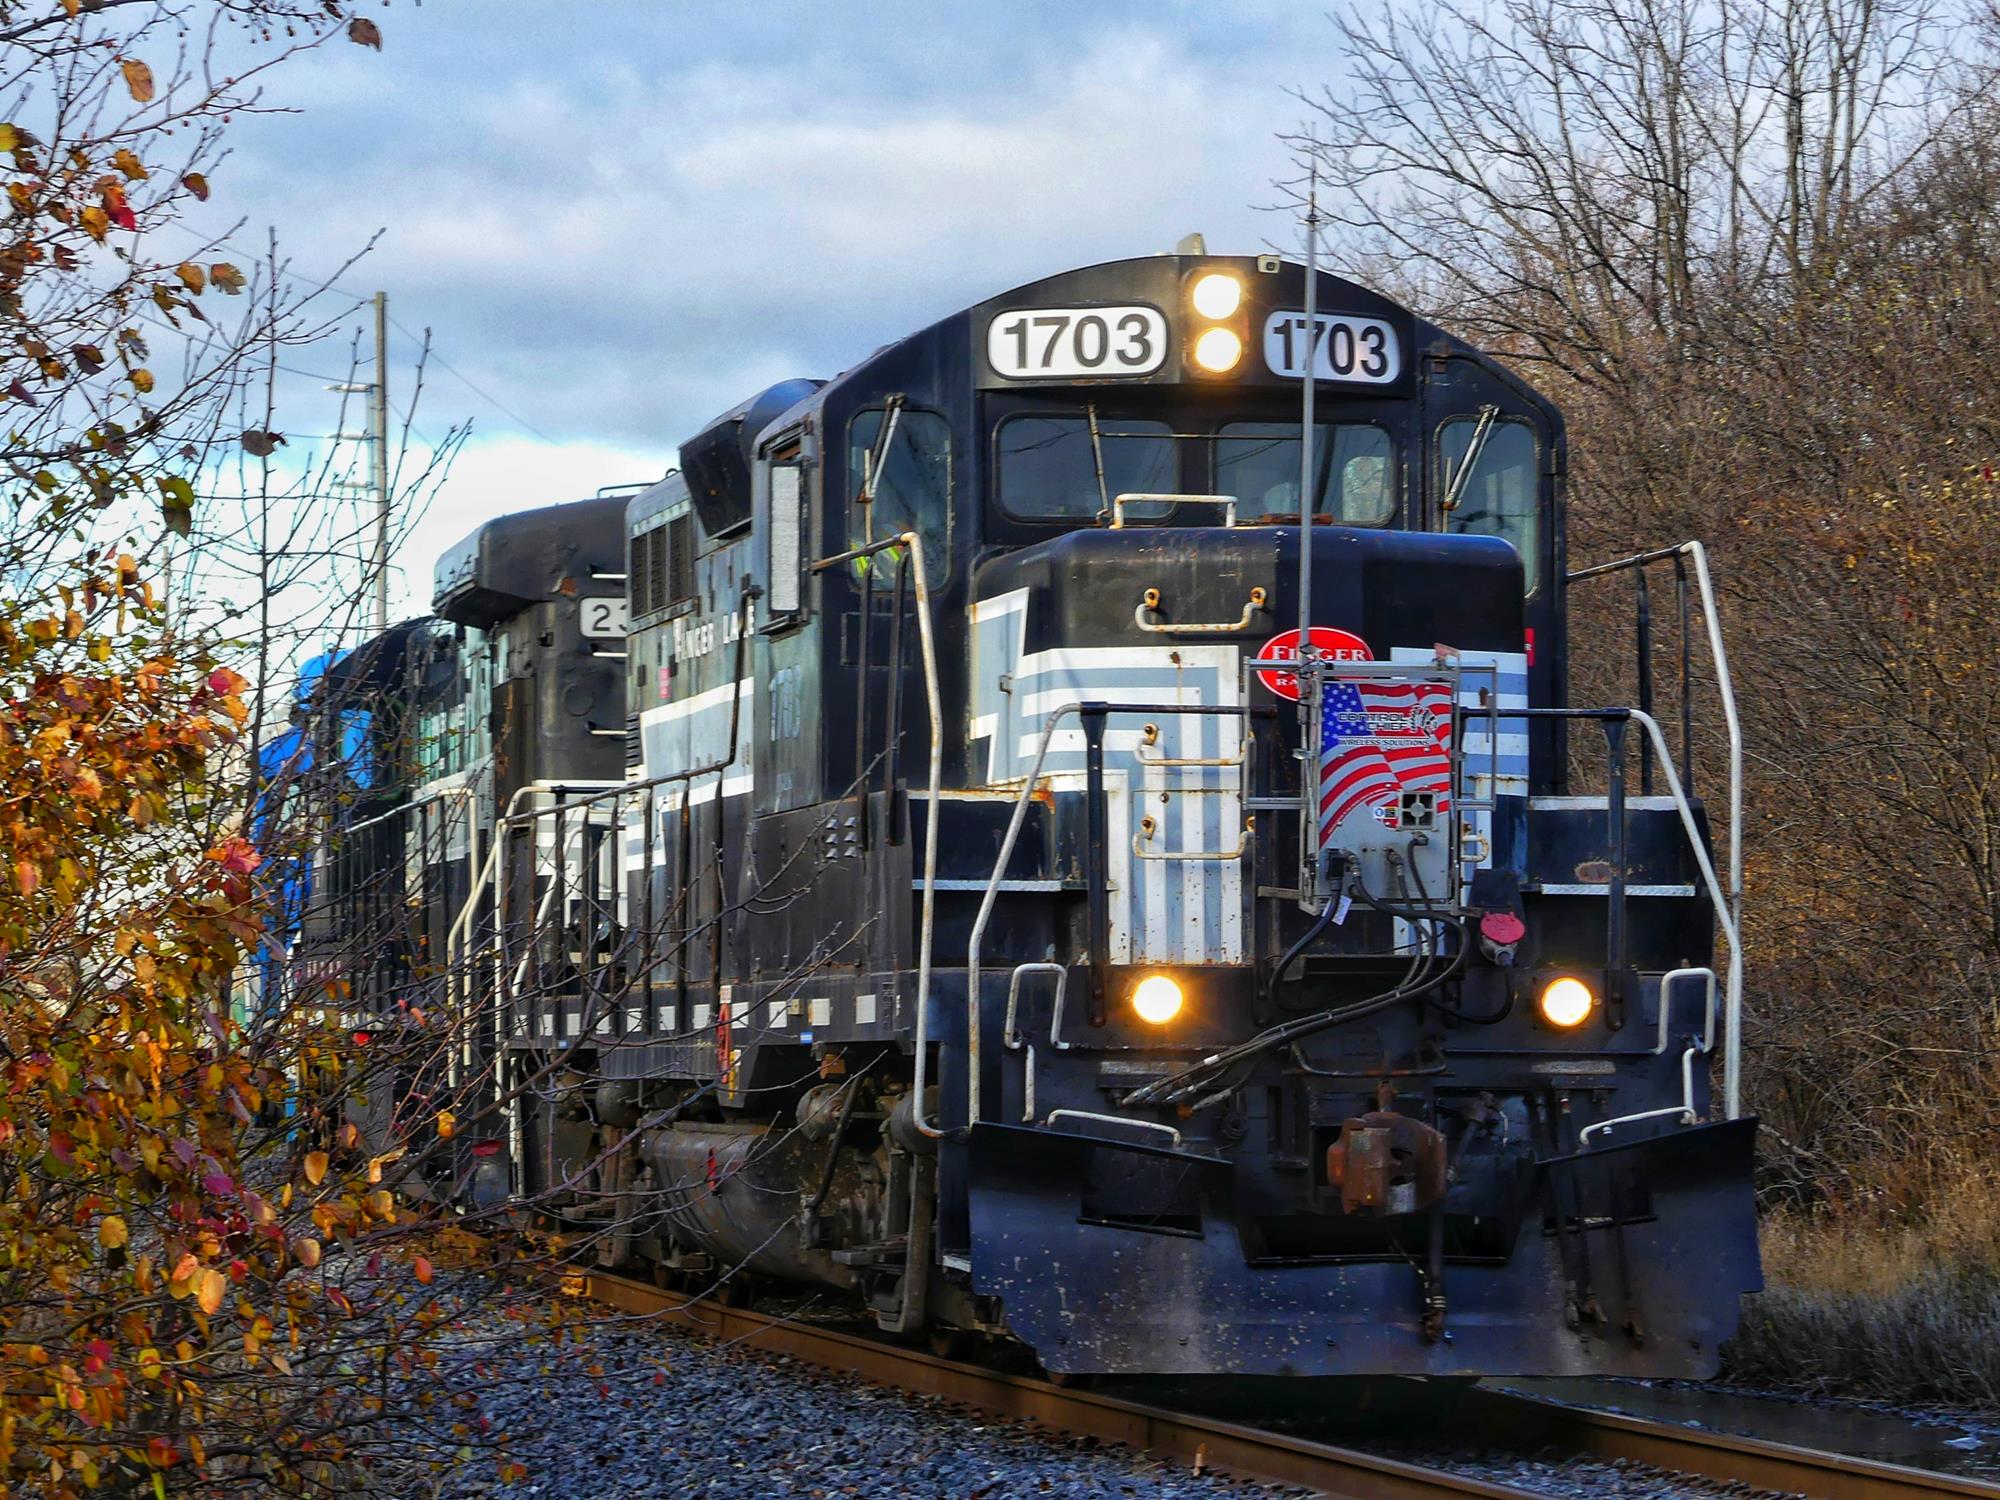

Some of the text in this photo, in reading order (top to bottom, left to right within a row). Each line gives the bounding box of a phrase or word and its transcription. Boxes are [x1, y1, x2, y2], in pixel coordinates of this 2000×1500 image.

[1004, 314, 1152, 370] 1703
[1273, 318, 1389, 378] 1703
[723, 605, 755, 644] LAE
[1272, 645, 1367, 661] FIGER
[1337, 711, 1407, 722] CONTROL
[1367, 722, 1407, 731] CHIEF
